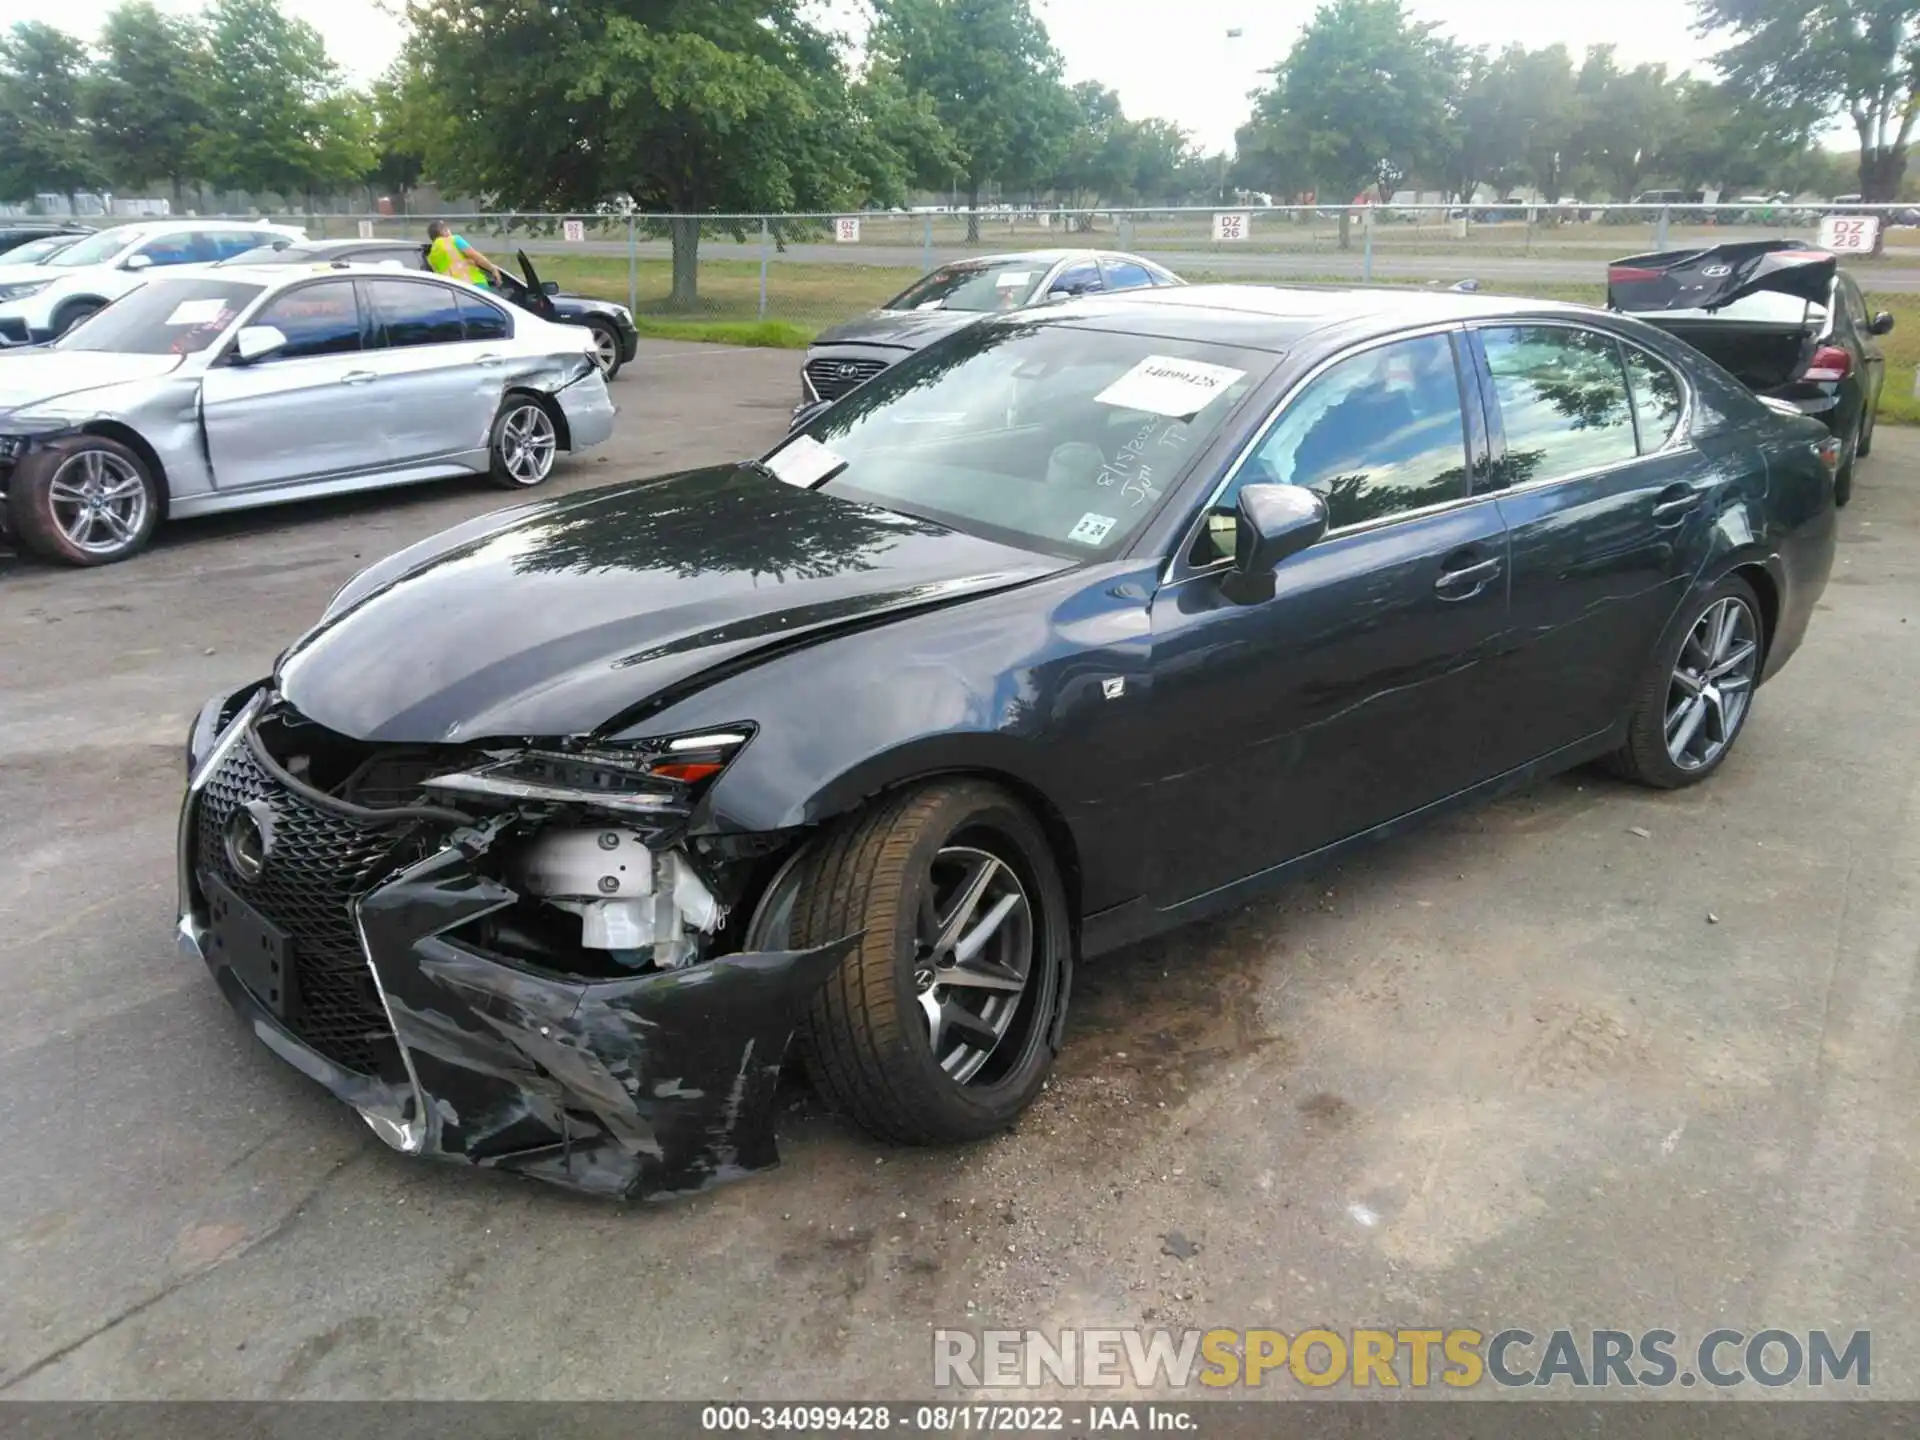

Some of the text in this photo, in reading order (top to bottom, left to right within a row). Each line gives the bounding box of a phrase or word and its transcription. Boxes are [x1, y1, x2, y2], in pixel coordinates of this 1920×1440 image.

[1222, 215, 1241, 227] DZ
[1834, 220, 1865, 234] DZ
[1223, 228, 1240, 238] 26
[1833, 234, 1861, 247] 28
